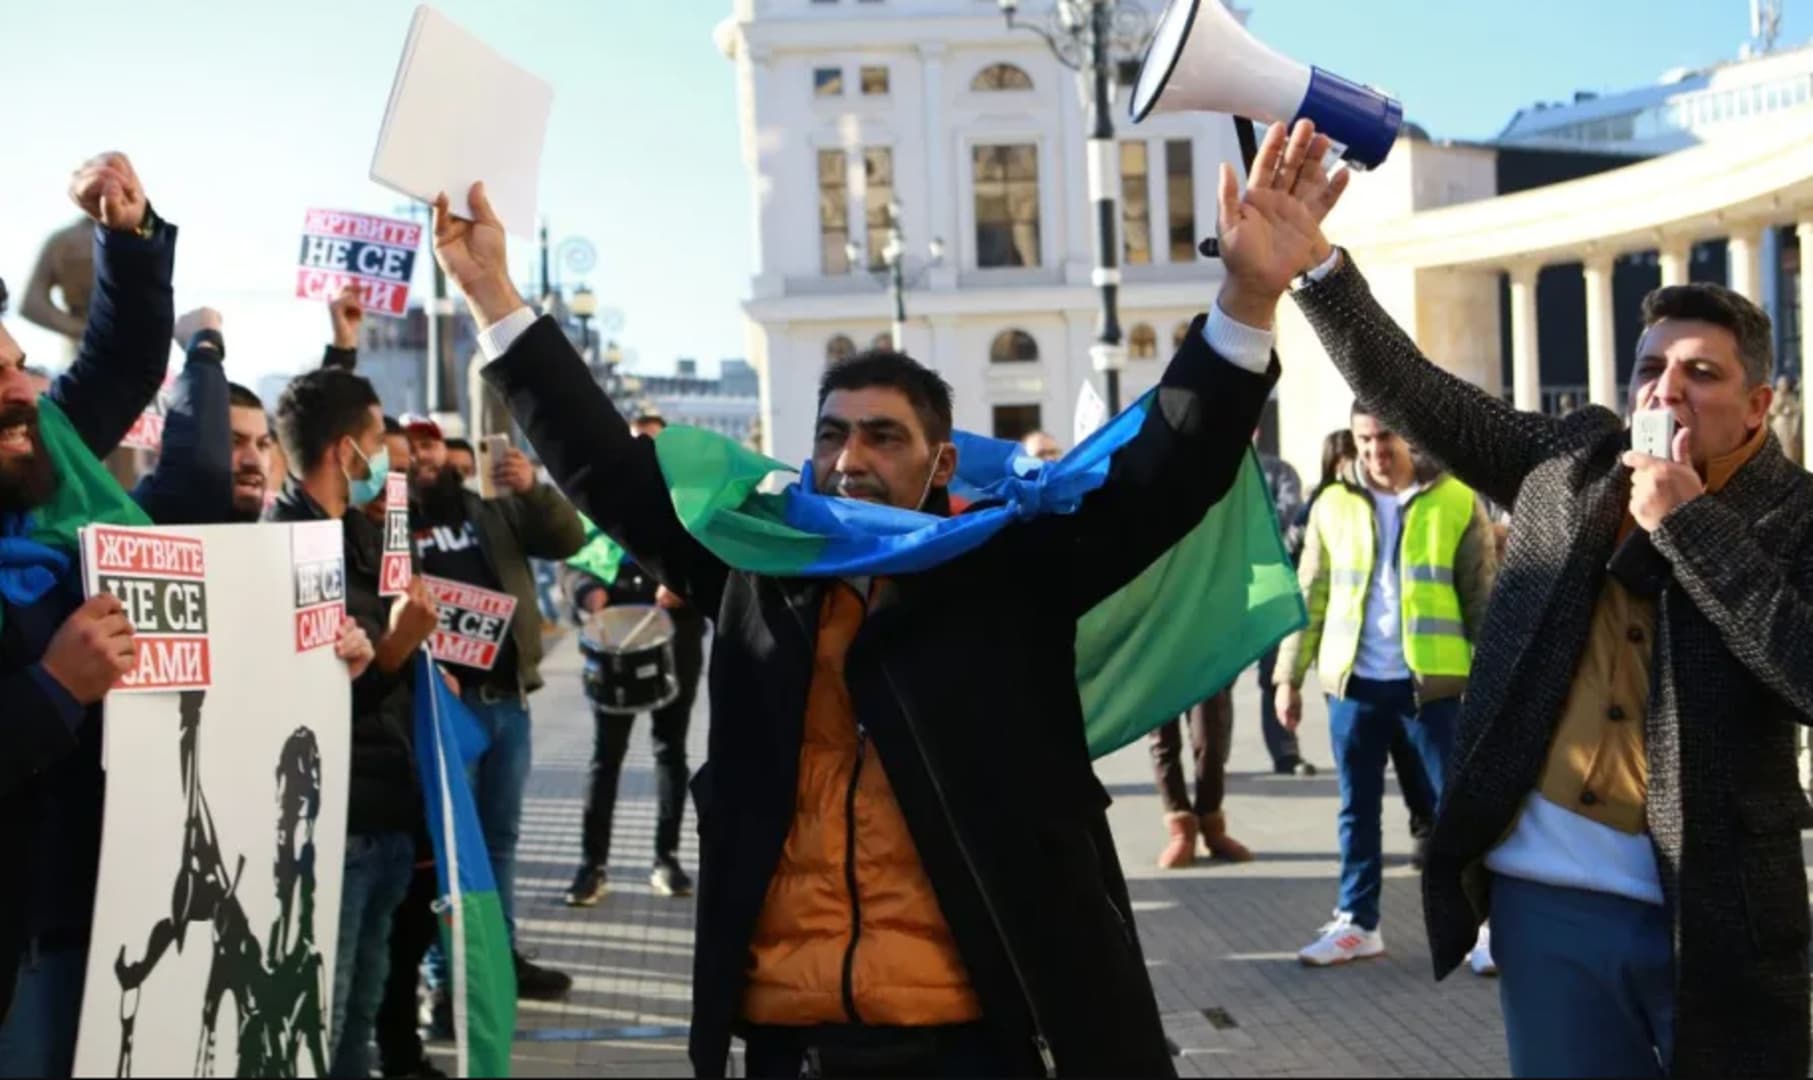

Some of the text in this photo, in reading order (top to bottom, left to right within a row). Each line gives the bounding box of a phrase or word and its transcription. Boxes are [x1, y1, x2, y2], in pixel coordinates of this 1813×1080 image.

[305, 236, 406, 278] НЕ СЕ
[99, 533, 205, 573] ЖРТВИТЕ
[297, 560, 342, 605] НЕ СЕ
[106, 579, 204, 631] НЕ СЕ
[458, 612, 500, 641] СЕ
